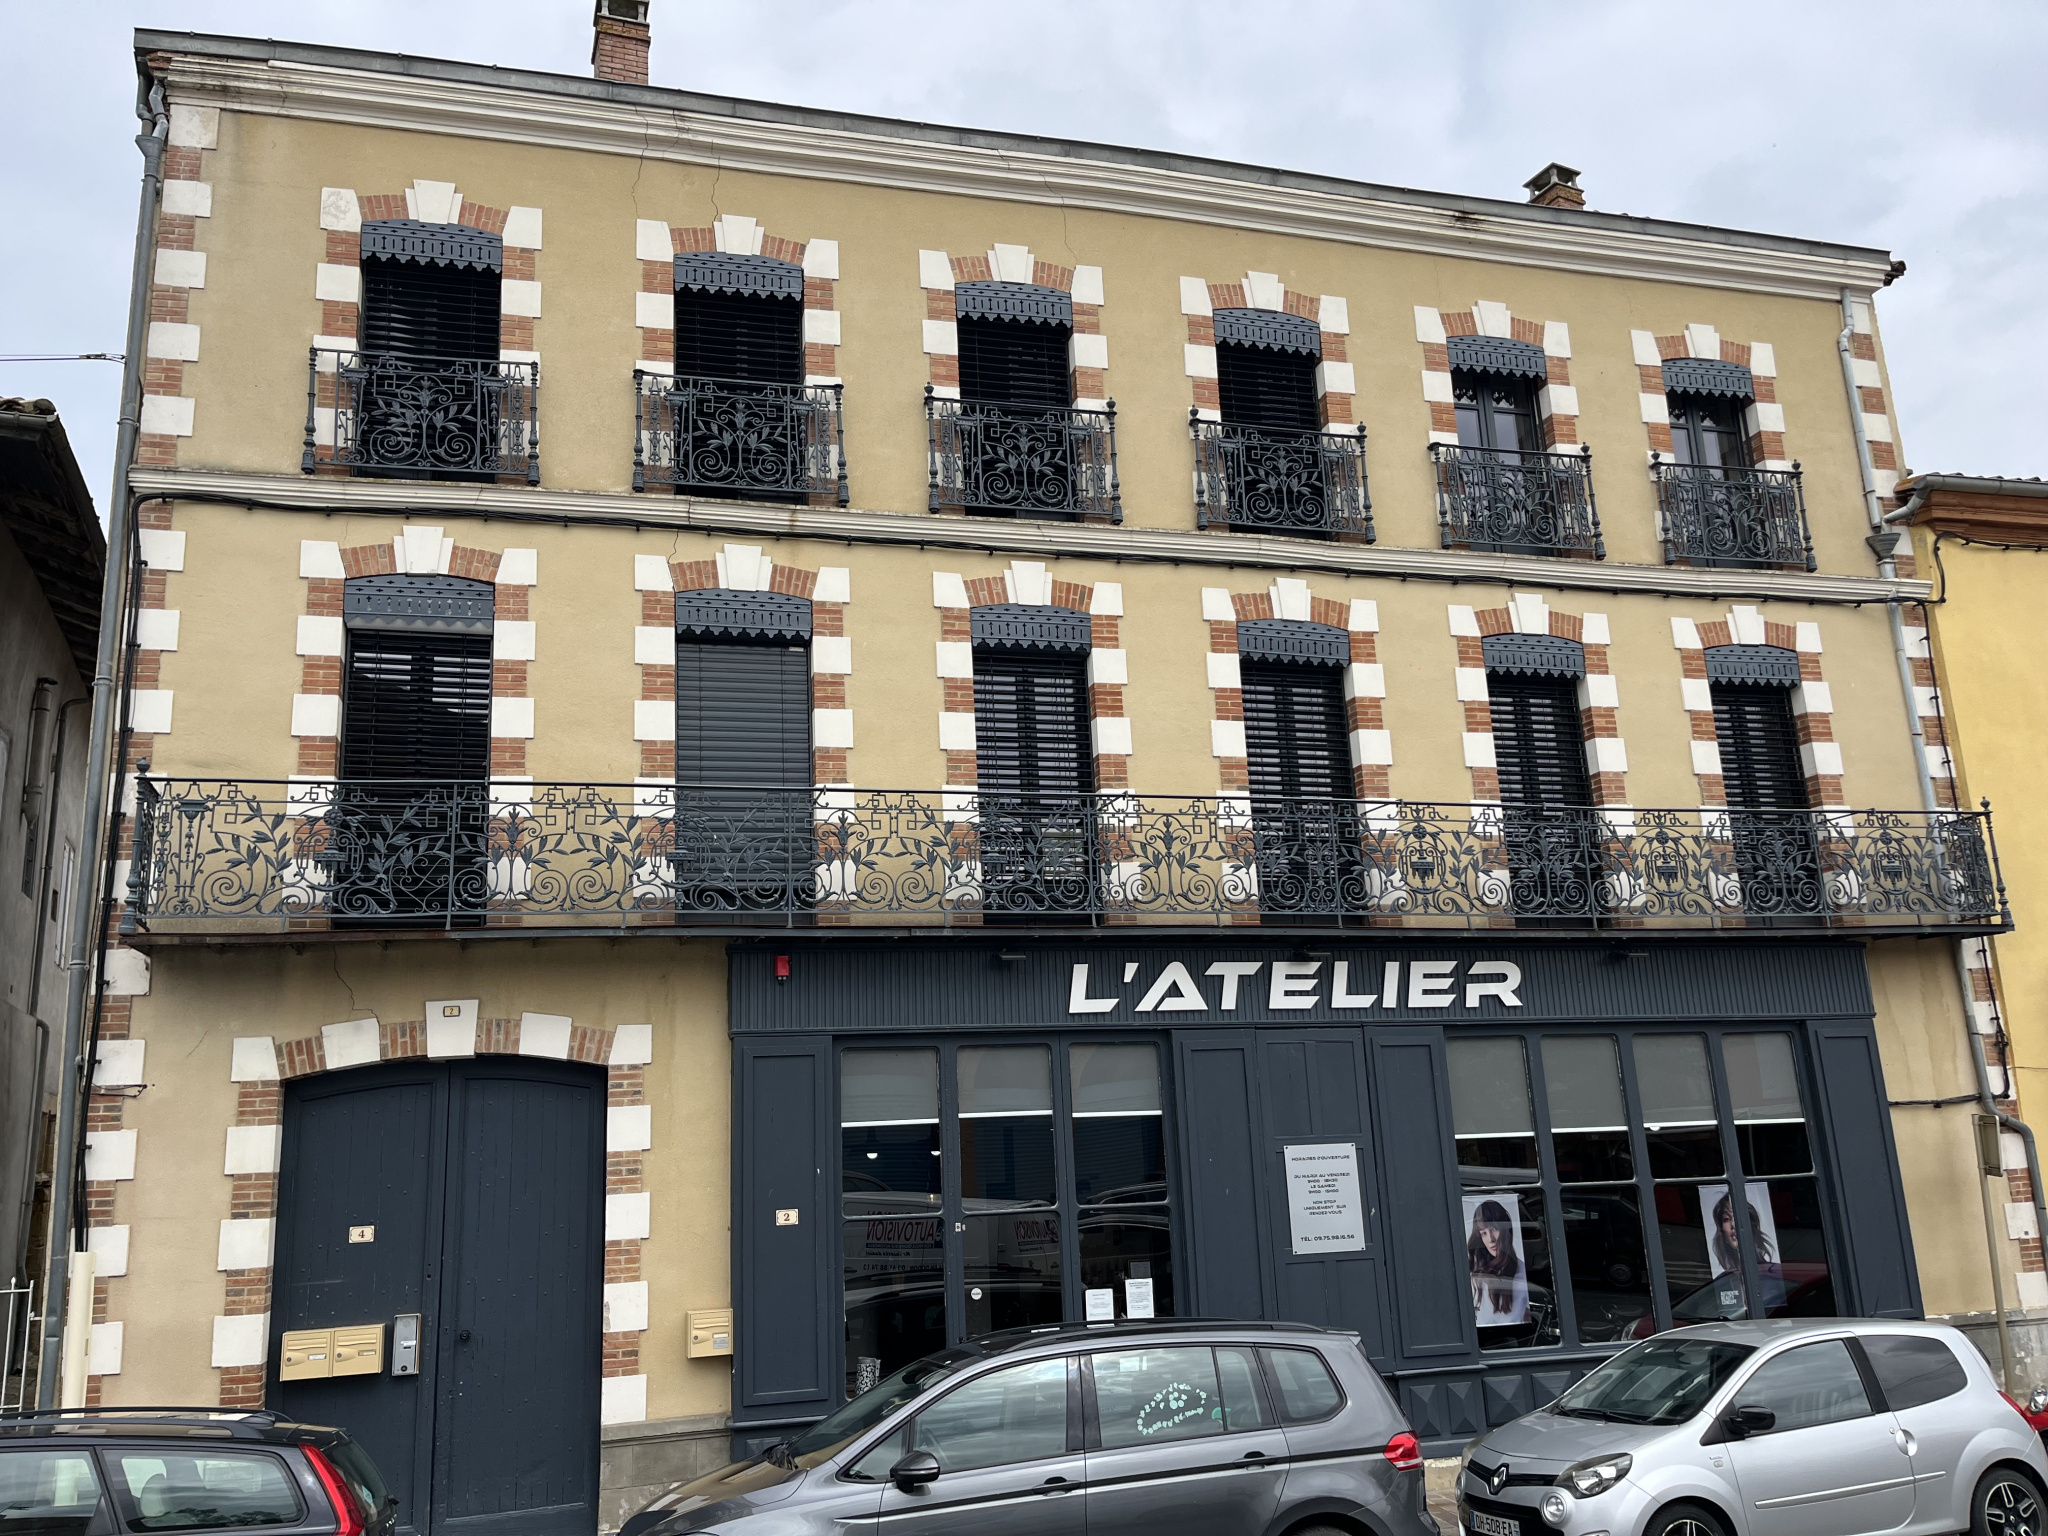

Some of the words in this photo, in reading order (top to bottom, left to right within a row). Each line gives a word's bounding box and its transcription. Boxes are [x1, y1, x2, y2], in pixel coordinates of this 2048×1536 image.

[1069, 961, 1524, 1013] L'ATELIER
[783, 1213, 790, 1221] 2
[358, 1229, 366, 1239] 4
